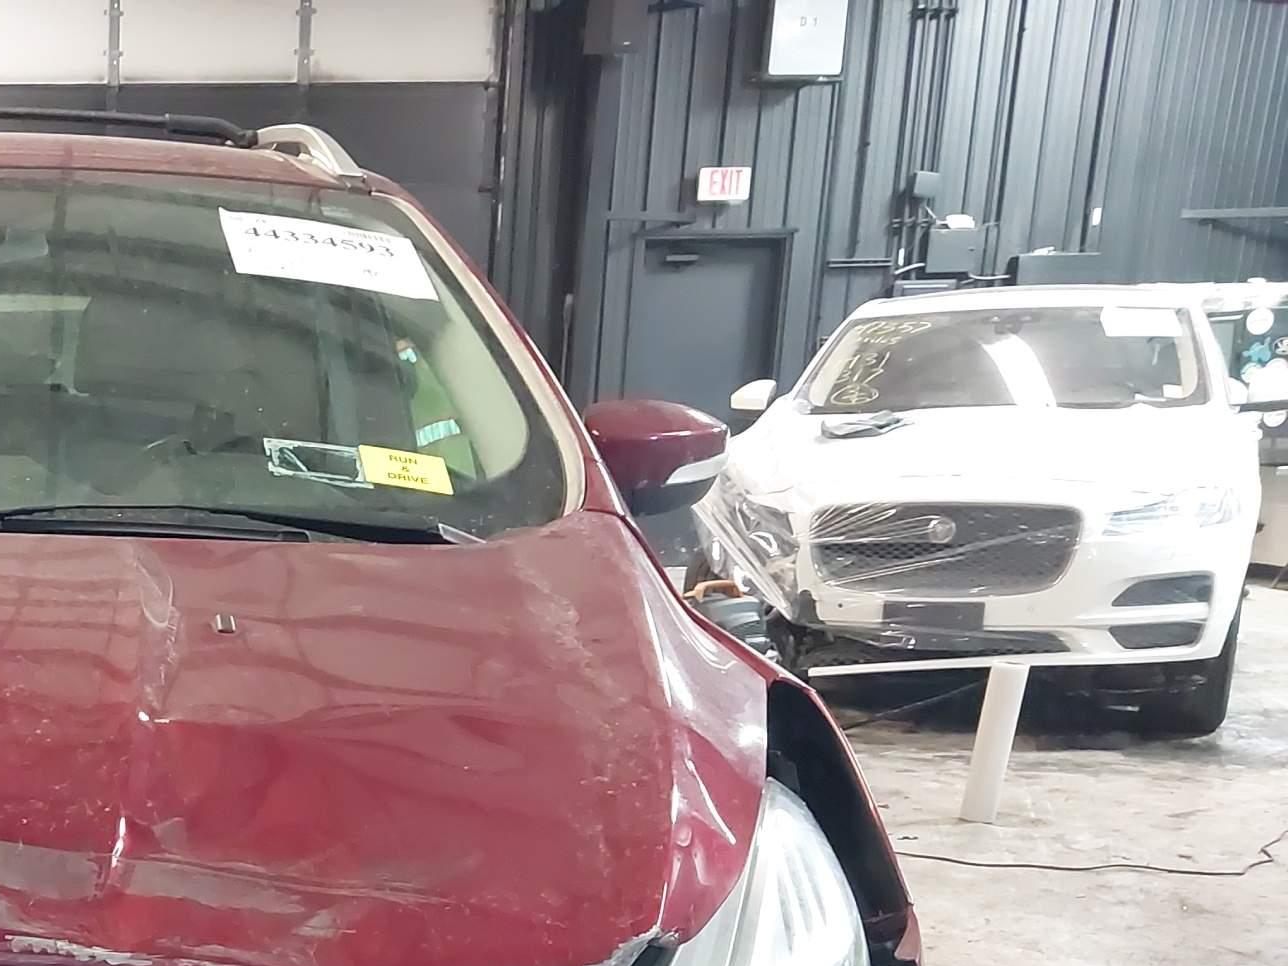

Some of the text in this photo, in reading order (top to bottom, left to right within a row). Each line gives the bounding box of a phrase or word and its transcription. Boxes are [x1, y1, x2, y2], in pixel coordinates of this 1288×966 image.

[709, 169, 743, 196] EXIT
[243, 226, 396, 257] 44334593
[388, 454, 418, 465] RUN
[401, 465, 410, 473] &
[387, 472, 431, 485] DRIVE
